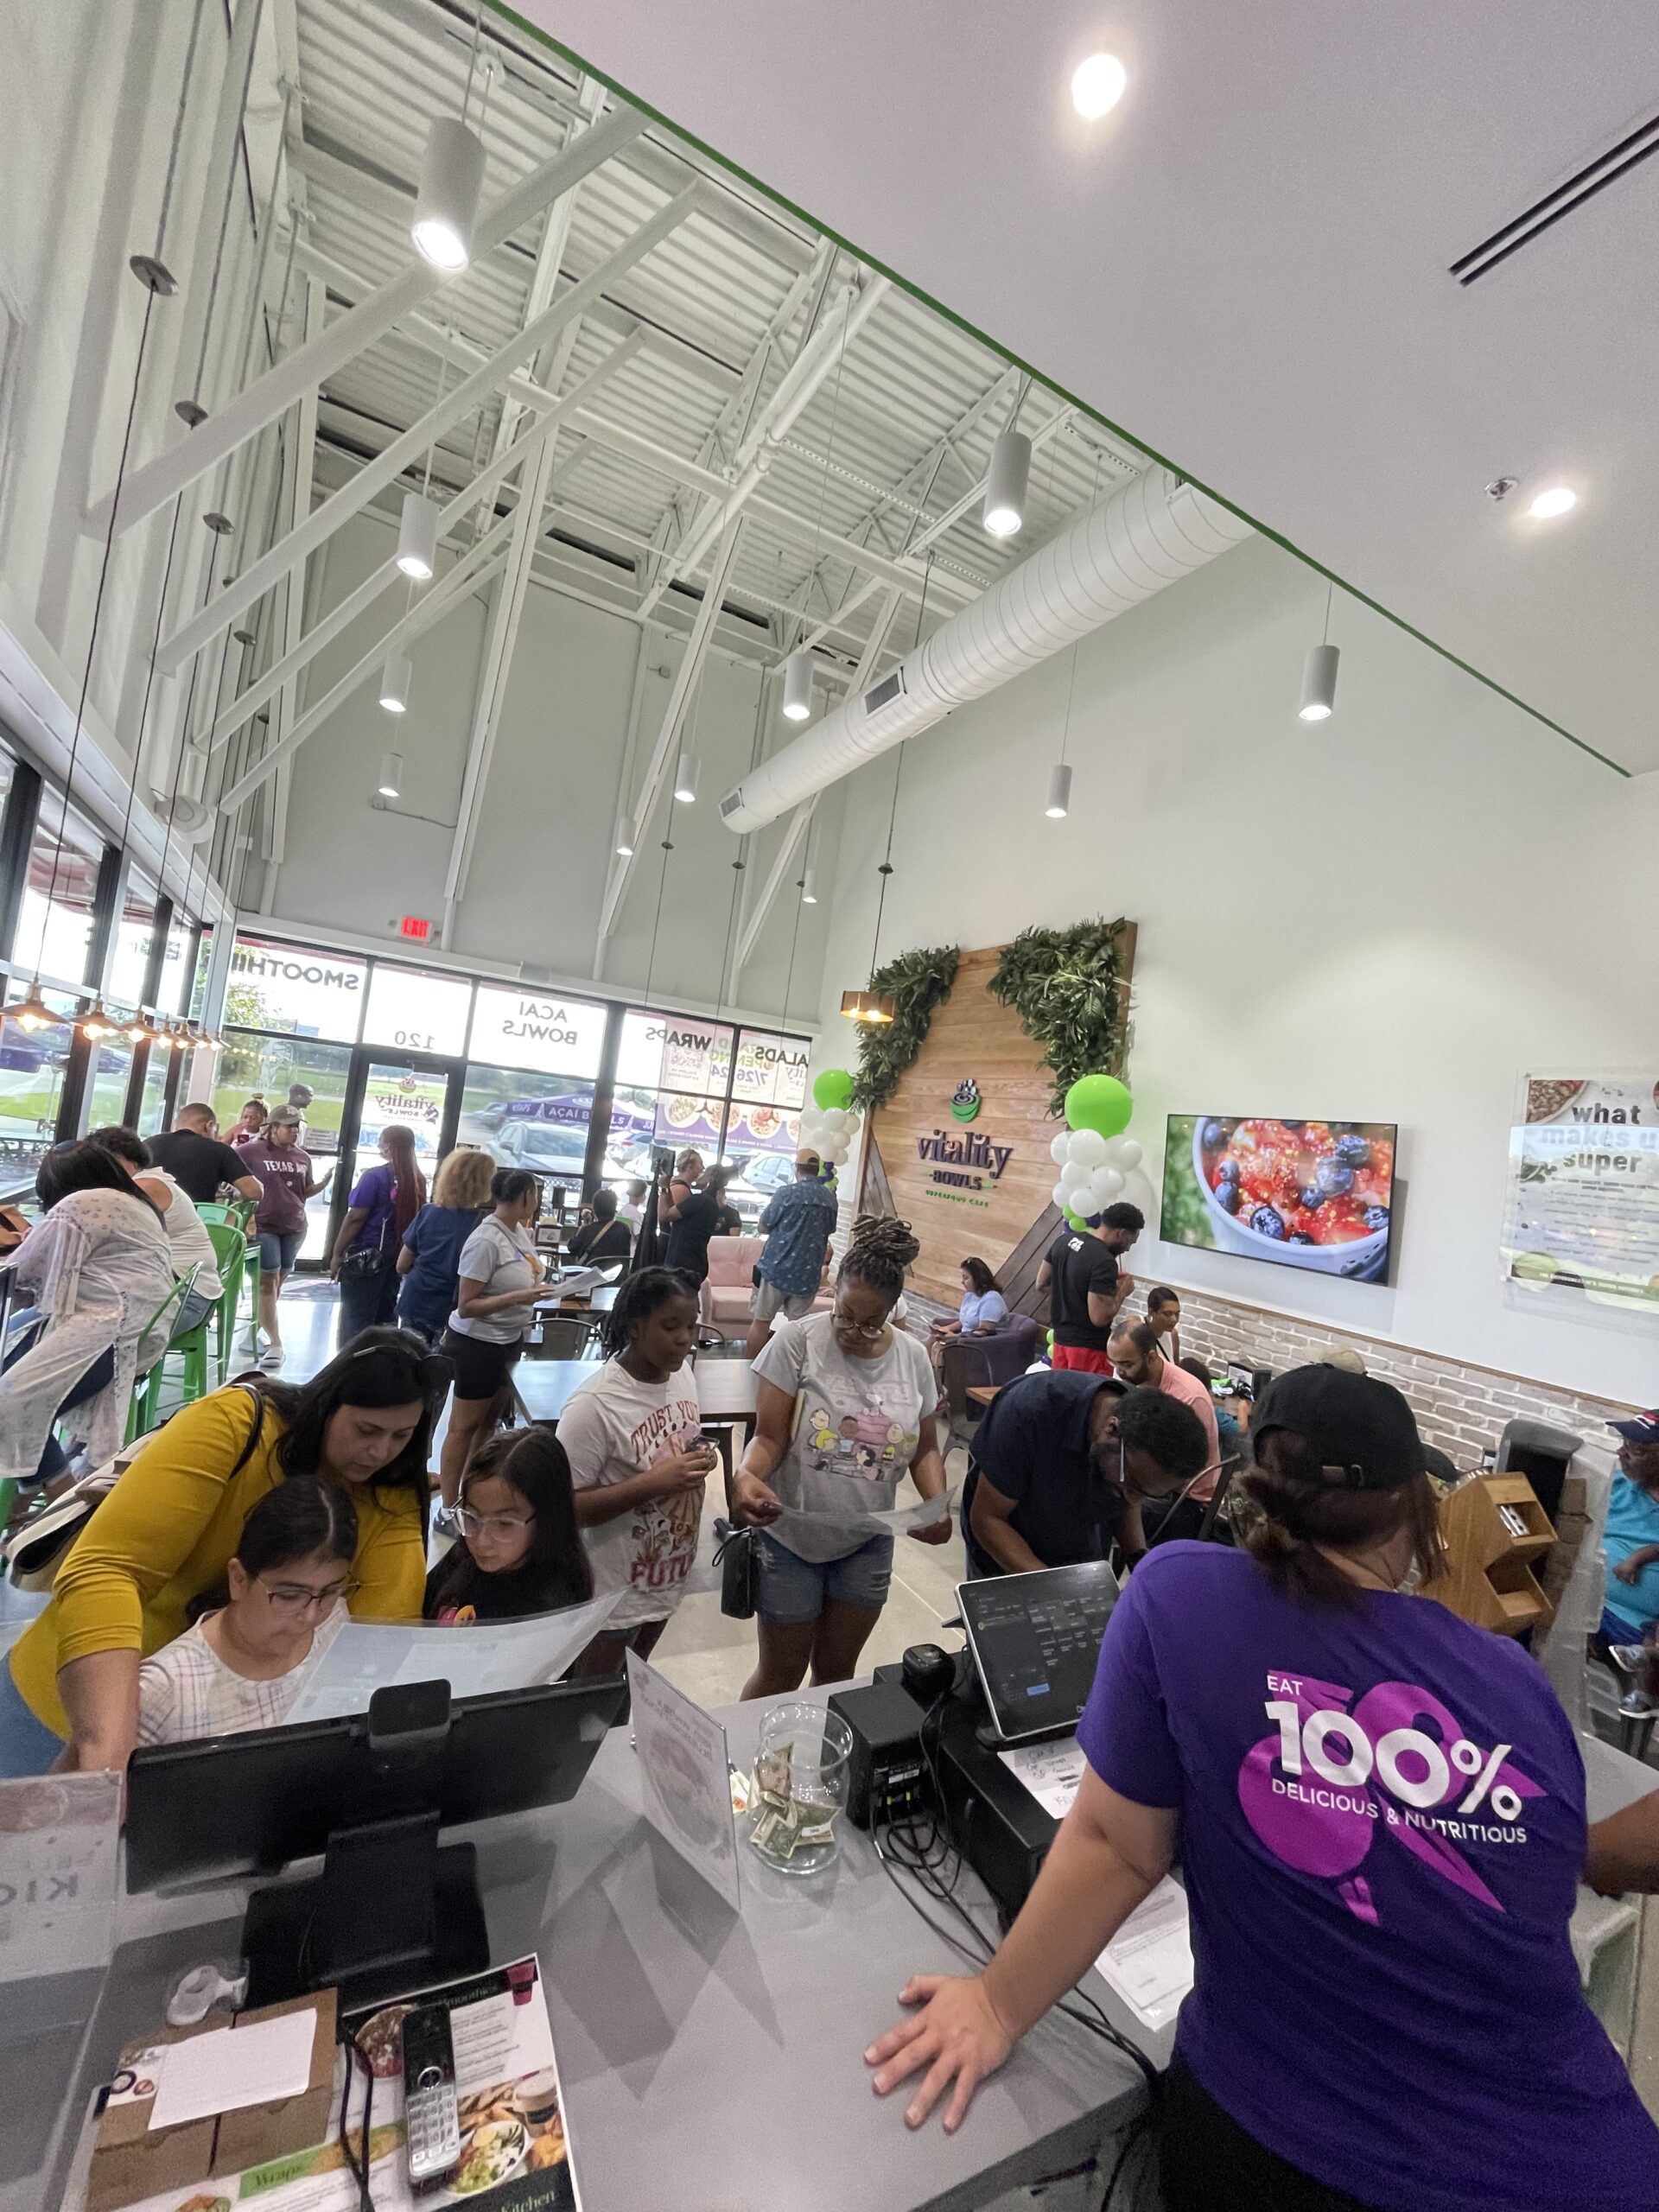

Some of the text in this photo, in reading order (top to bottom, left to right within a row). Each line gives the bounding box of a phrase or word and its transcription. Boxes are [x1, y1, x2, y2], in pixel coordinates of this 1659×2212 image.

[404, 917, 429, 939] EXIT
[549, 1106, 626, 1124] AÇAÍ BLS
[1572, 1103, 1641, 1125] what
[1541, 1125, 1659, 1149] makes u
[918, 1128, 1014, 1179] vitality
[1562, 1153, 1643, 1176] super
[263, 1160, 295, 1173] TEXAS
[933, 1169, 982, 1191] BOWLS
[631, 1400, 700, 1465] TRUST YOU
[1267, 1675, 1303, 1696] EAT
[1264, 1700, 1523, 1821] 100%
[1271, 1777, 1528, 1844] DELICIOUS & NUTRITIOUS
